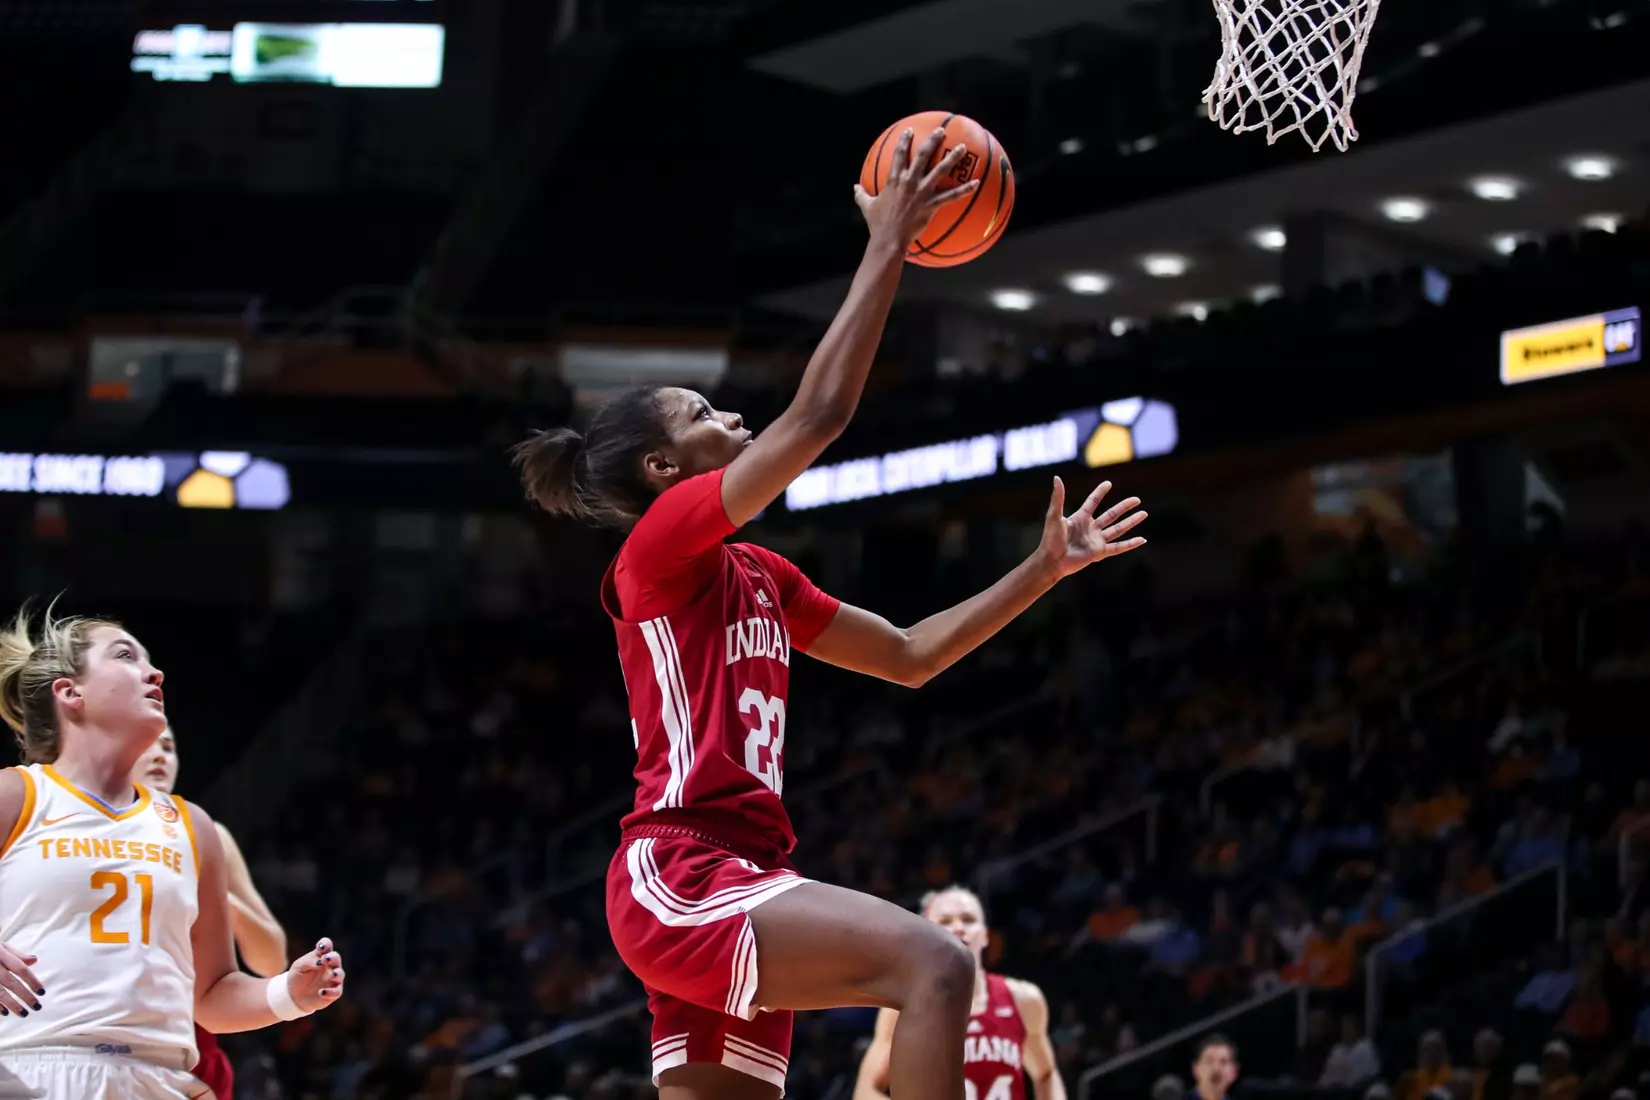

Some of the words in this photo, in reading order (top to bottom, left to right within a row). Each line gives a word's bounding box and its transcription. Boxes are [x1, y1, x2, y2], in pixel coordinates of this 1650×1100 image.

[726, 617, 790, 667] INDIA
[38, 837, 183, 873] TENNESSEE
[90, 871, 154, 945] 21
